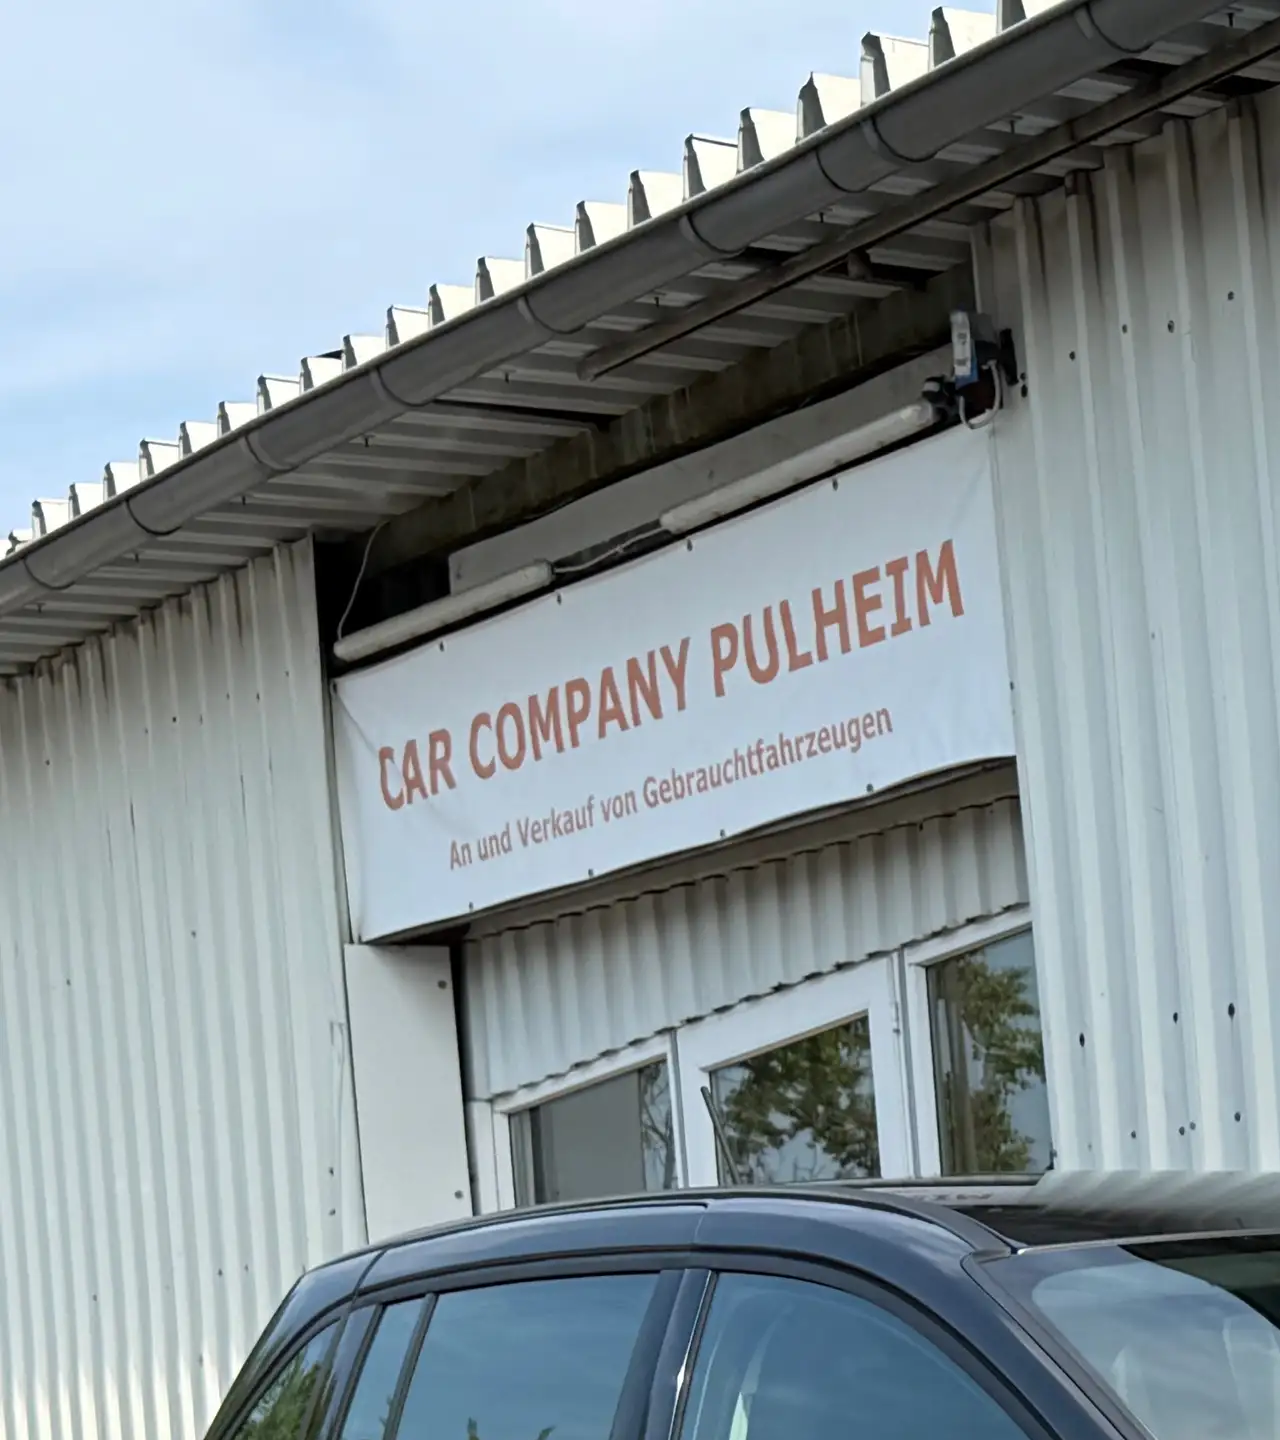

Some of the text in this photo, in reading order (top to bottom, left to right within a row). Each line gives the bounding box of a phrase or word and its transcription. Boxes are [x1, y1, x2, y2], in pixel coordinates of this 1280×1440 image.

[377, 539, 966, 811] CAR COMPANY PULHEIM
[448, 706, 894, 870] An und Verkauf von Gebrauchtfahrzeugen
